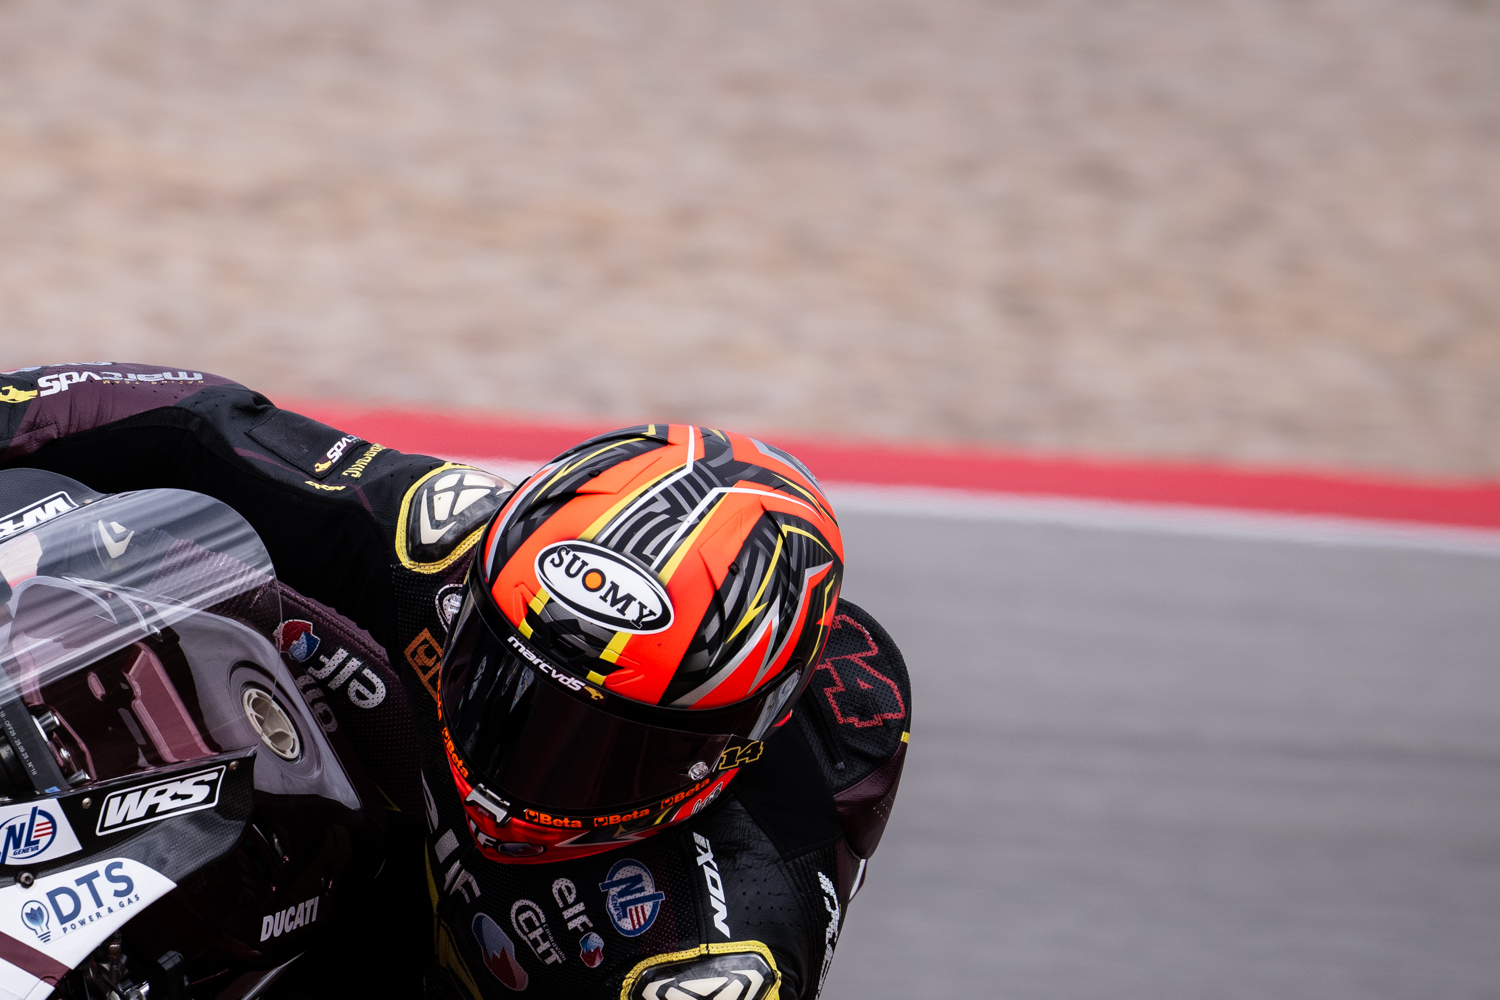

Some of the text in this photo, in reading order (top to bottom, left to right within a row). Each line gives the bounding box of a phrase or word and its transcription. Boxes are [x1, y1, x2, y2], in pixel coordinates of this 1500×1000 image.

[549, 546, 657, 629] SUOMY
[307, 648, 387, 709] elf
[507, 635, 587, 692] marcvds
[446, 737, 470, 779] Beta
[717, 740, 765, 771] 14
[103, 771, 220, 828] WRS
[609, 807, 650, 825] Beta
[674, 777, 711, 805] Beta
[0, 805, 41, 864] NL
[539, 813, 583, 829] Beta
[12, 844, 40, 857] GENEVA
[46, 861, 135, 926] DTS
[552, 877, 594, 933] elf
[599, 873, 665, 919] NL
[692, 831, 731, 939] IXON
[62, 912, 104, 935] POWER
[118, 893, 141, 910] GAS
[260, 895, 321, 942] DUCATI
[516, 909, 564, 966] CHT
